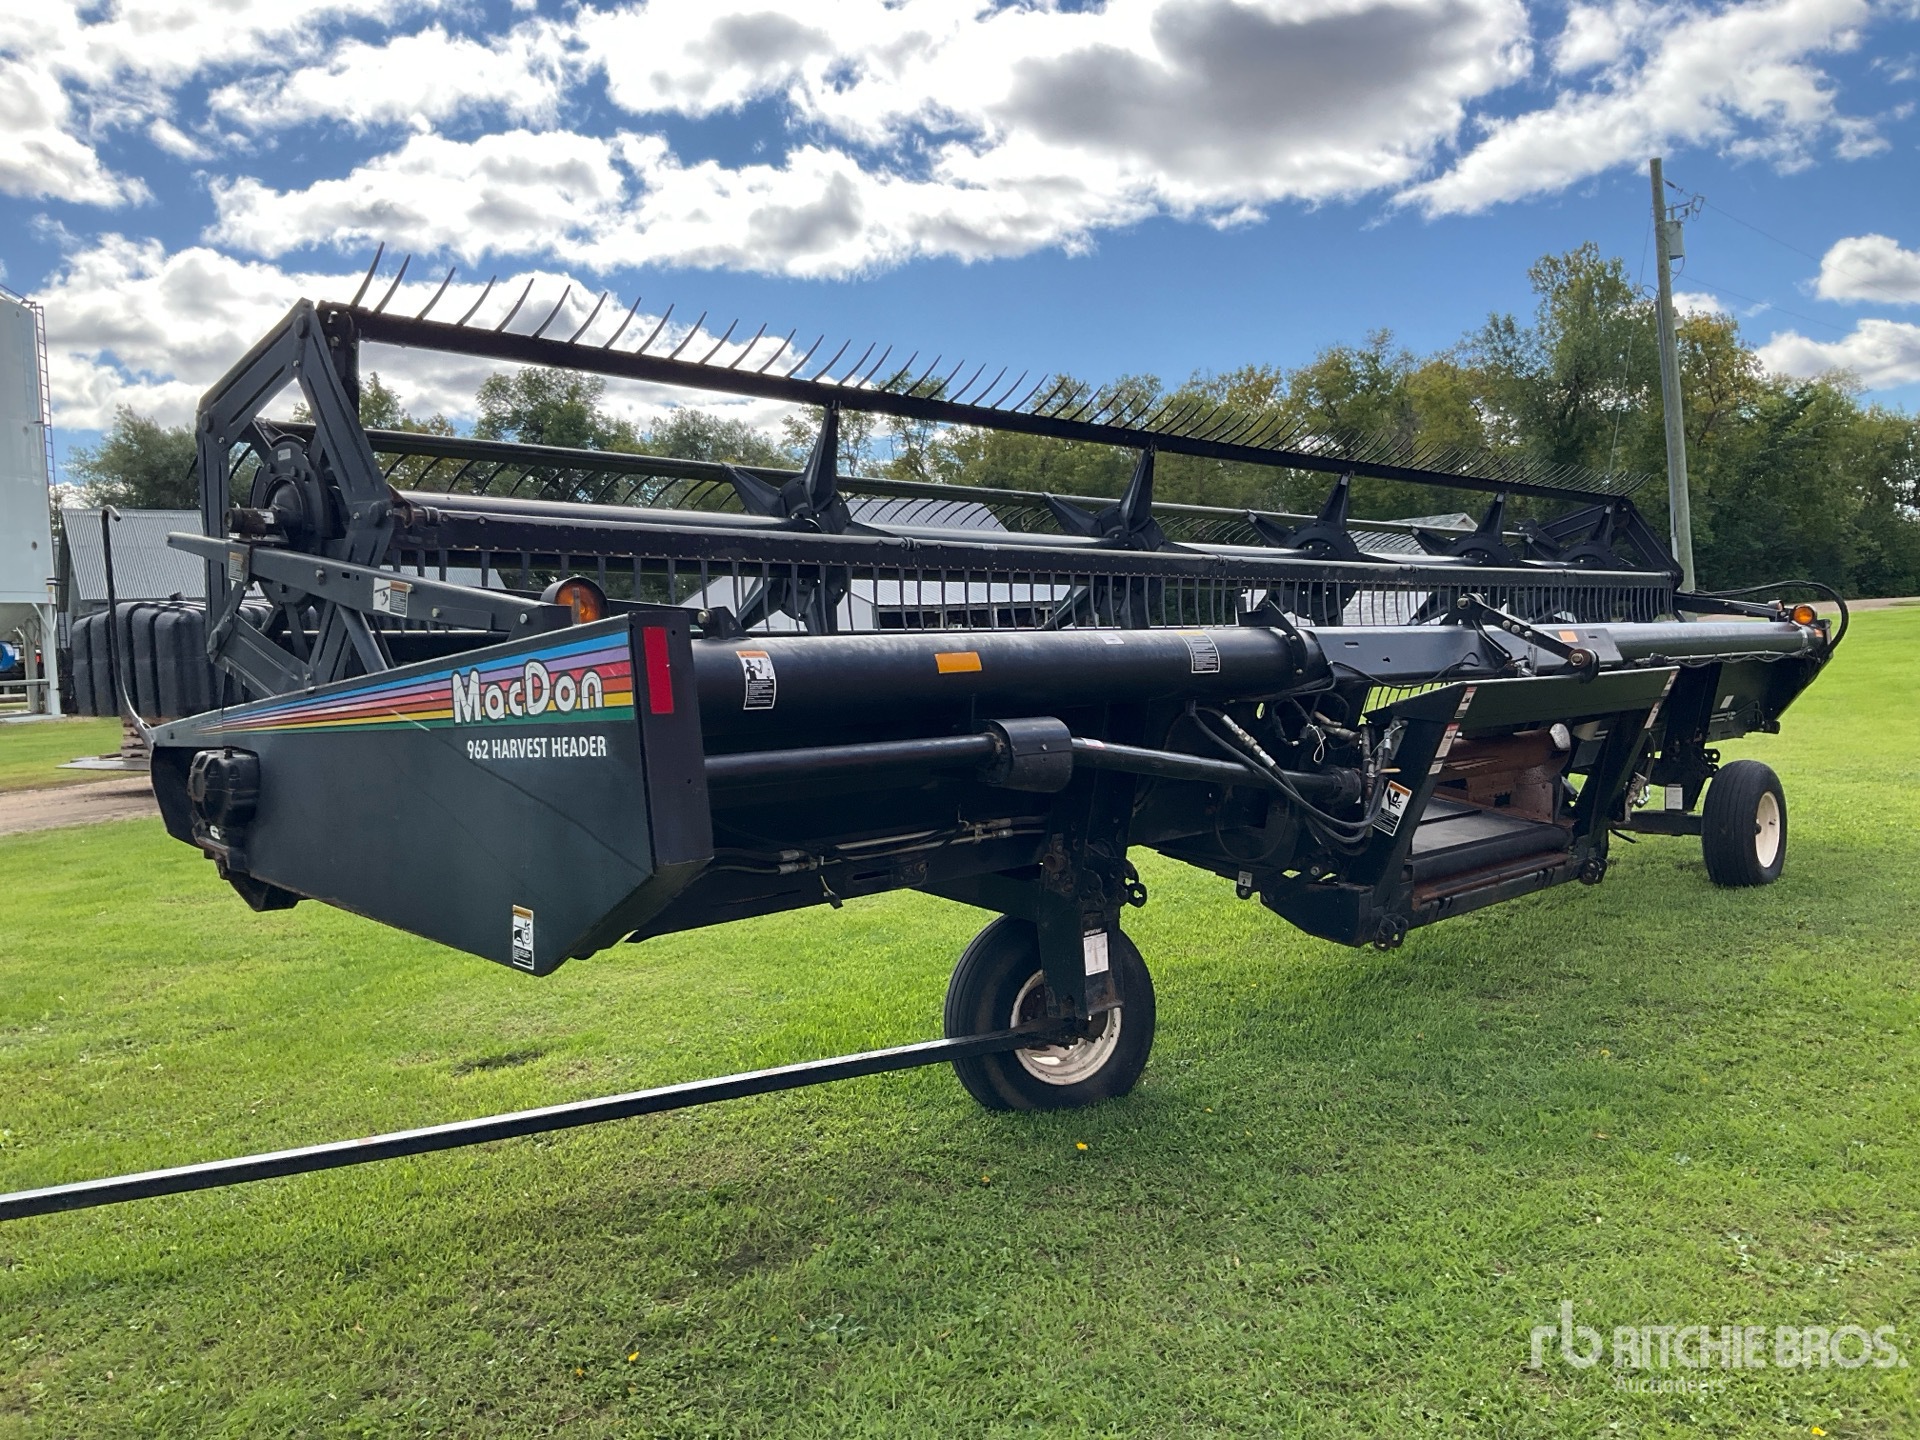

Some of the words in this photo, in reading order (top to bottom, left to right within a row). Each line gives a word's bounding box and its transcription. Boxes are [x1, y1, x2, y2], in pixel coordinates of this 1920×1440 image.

[452, 659, 603, 724] MacDon
[467, 739, 489, 759] 962
[492, 737, 547, 759] HARVEST
[551, 735, 607, 757] HEADER
